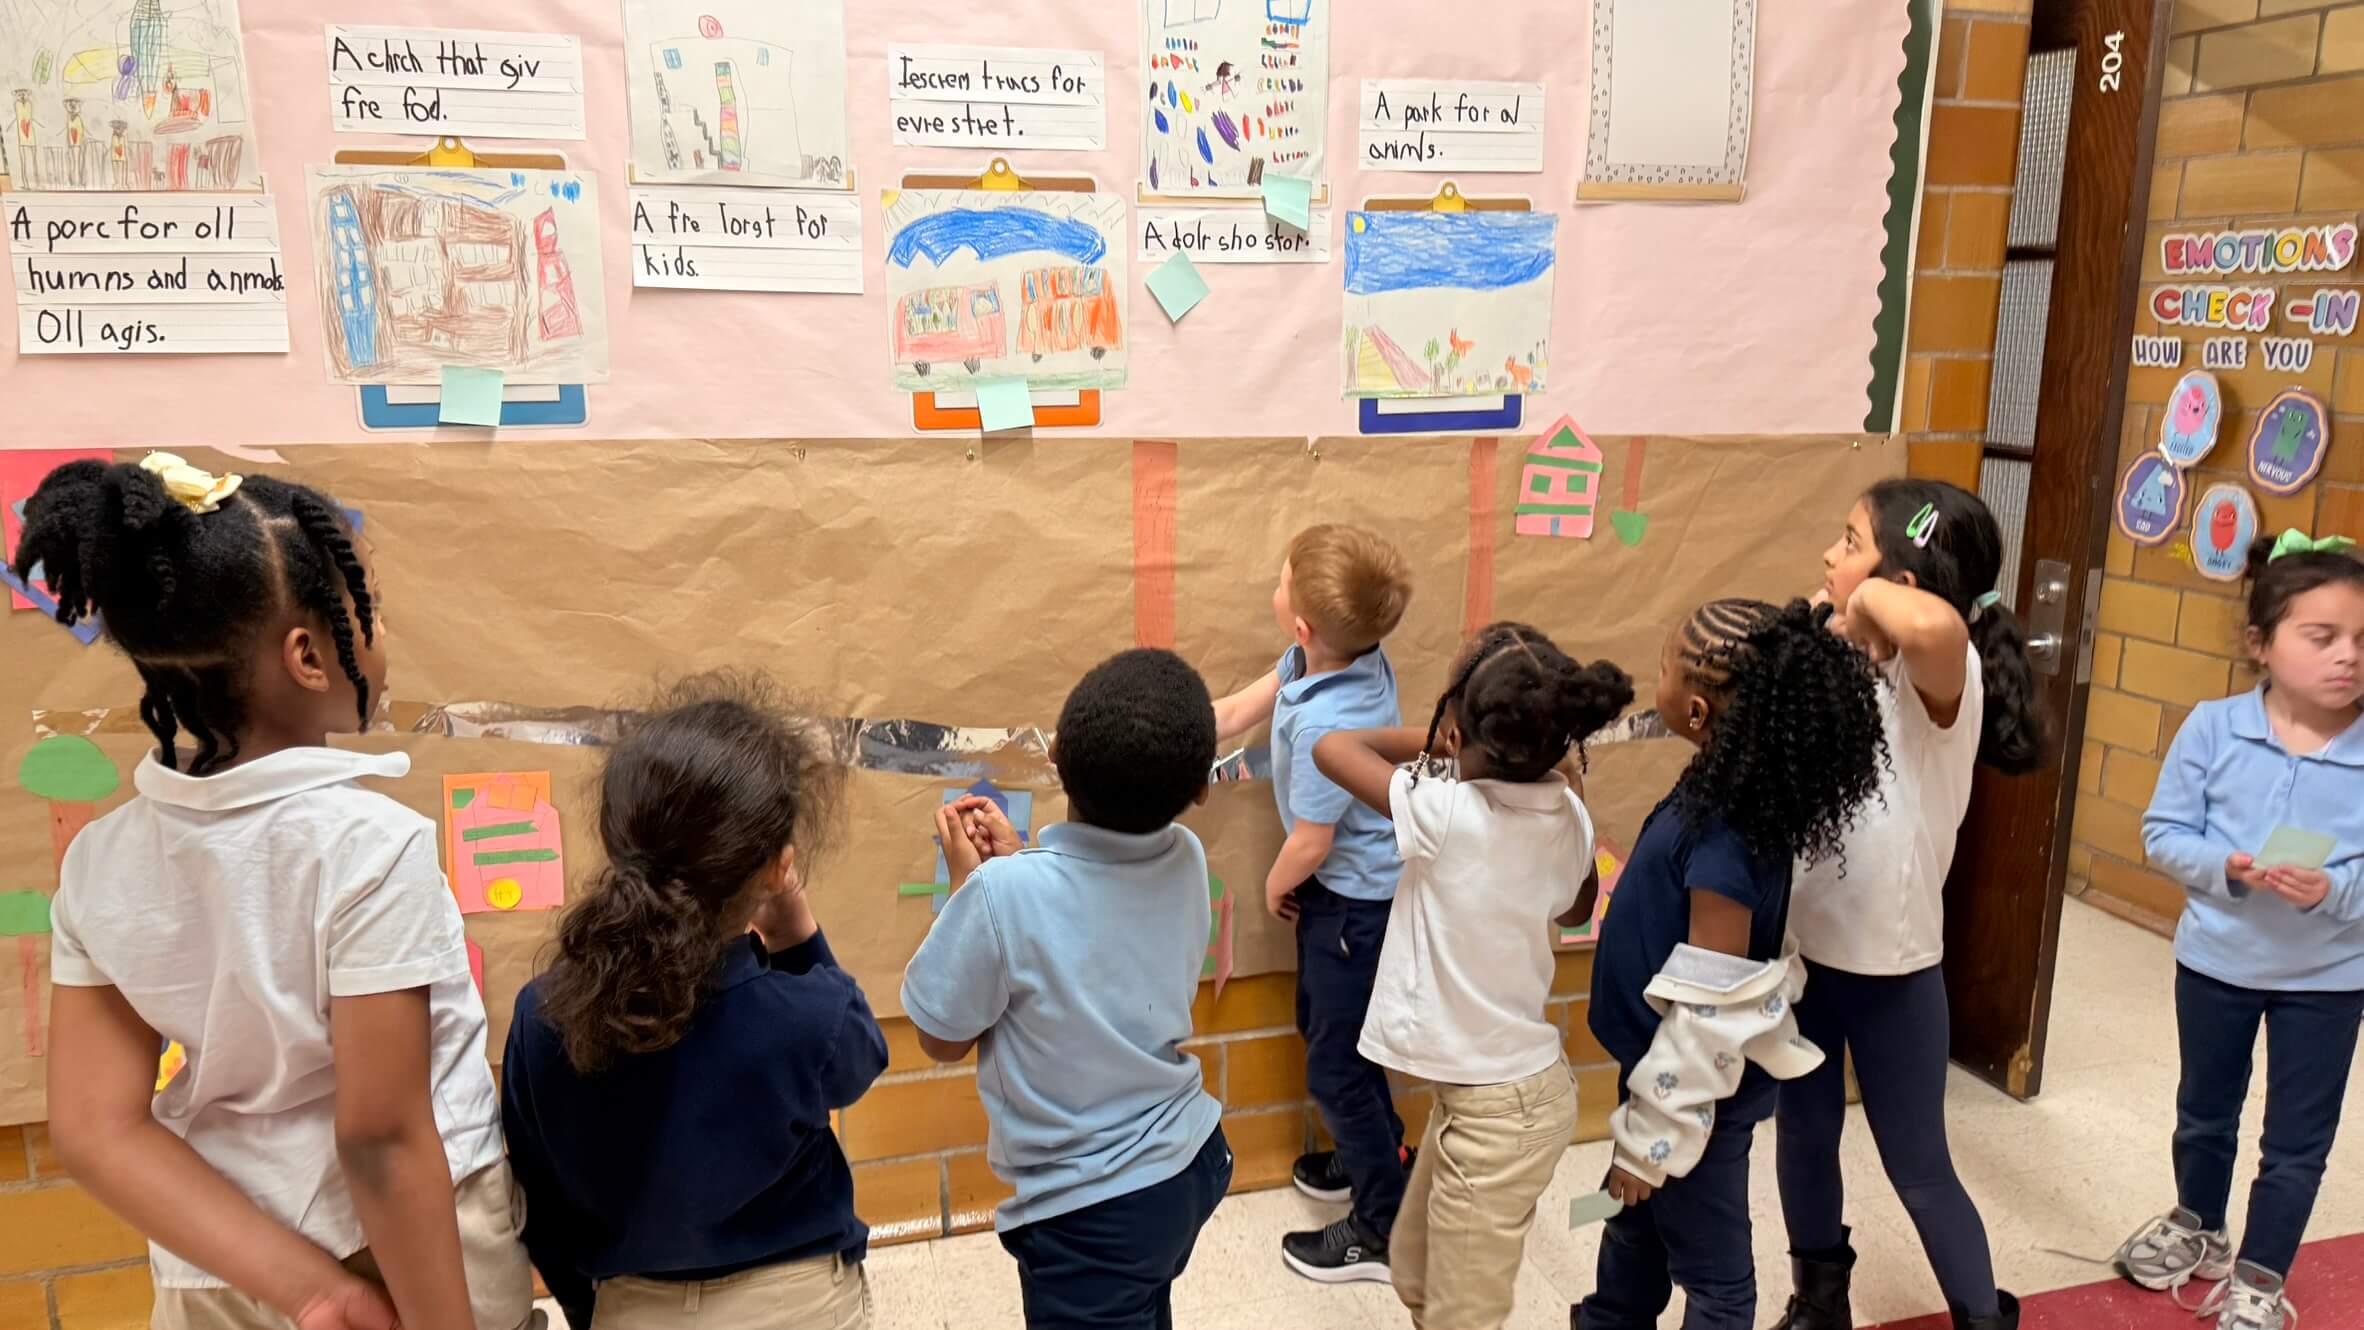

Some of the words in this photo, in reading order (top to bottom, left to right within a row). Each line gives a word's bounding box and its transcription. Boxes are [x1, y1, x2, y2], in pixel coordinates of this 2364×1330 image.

[333, 36, 363, 72] A
[367, 39, 423, 74] chrch
[436, 39, 488, 77] that
[500, 54, 540, 90] giv
[1052, 64, 1086, 94] for
[2100, 30, 2124, 93] 204
[342, 85, 383, 120] fre
[403, 86, 448, 122] fod.
[897, 115, 944, 133] evre
[952, 103, 1024, 136] stret.
[1374, 90, 1391, 120] A
[1405, 91, 1442, 130] park
[1454, 92, 1490, 122] for
[10, 205, 32, 240] A
[47, 219, 110, 253] porc
[117, 205, 178, 239] for
[195, 205, 234, 239] oll
[633, 201, 654, 233] A
[667, 200, 701, 233] fre
[796, 205, 828, 240] for
[1145, 221, 1167, 250] A
[1218, 224, 1257, 250] sho
[1265, 223, 1310, 252] stor.
[642, 244, 699, 277] kids.
[2164, 229, 2354, 269] EMOTIONS
[28, 256, 134, 294] humns
[147, 256, 187, 290] and
[2154, 289, 2272, 327] CHECK
[37, 308, 83, 348] Oll
[100, 321, 165, 350] agis.
[2134, 339, 2179, 363] HOW
[2206, 341, 2244, 365] ARE
[2264, 342, 2310, 368] YOU
